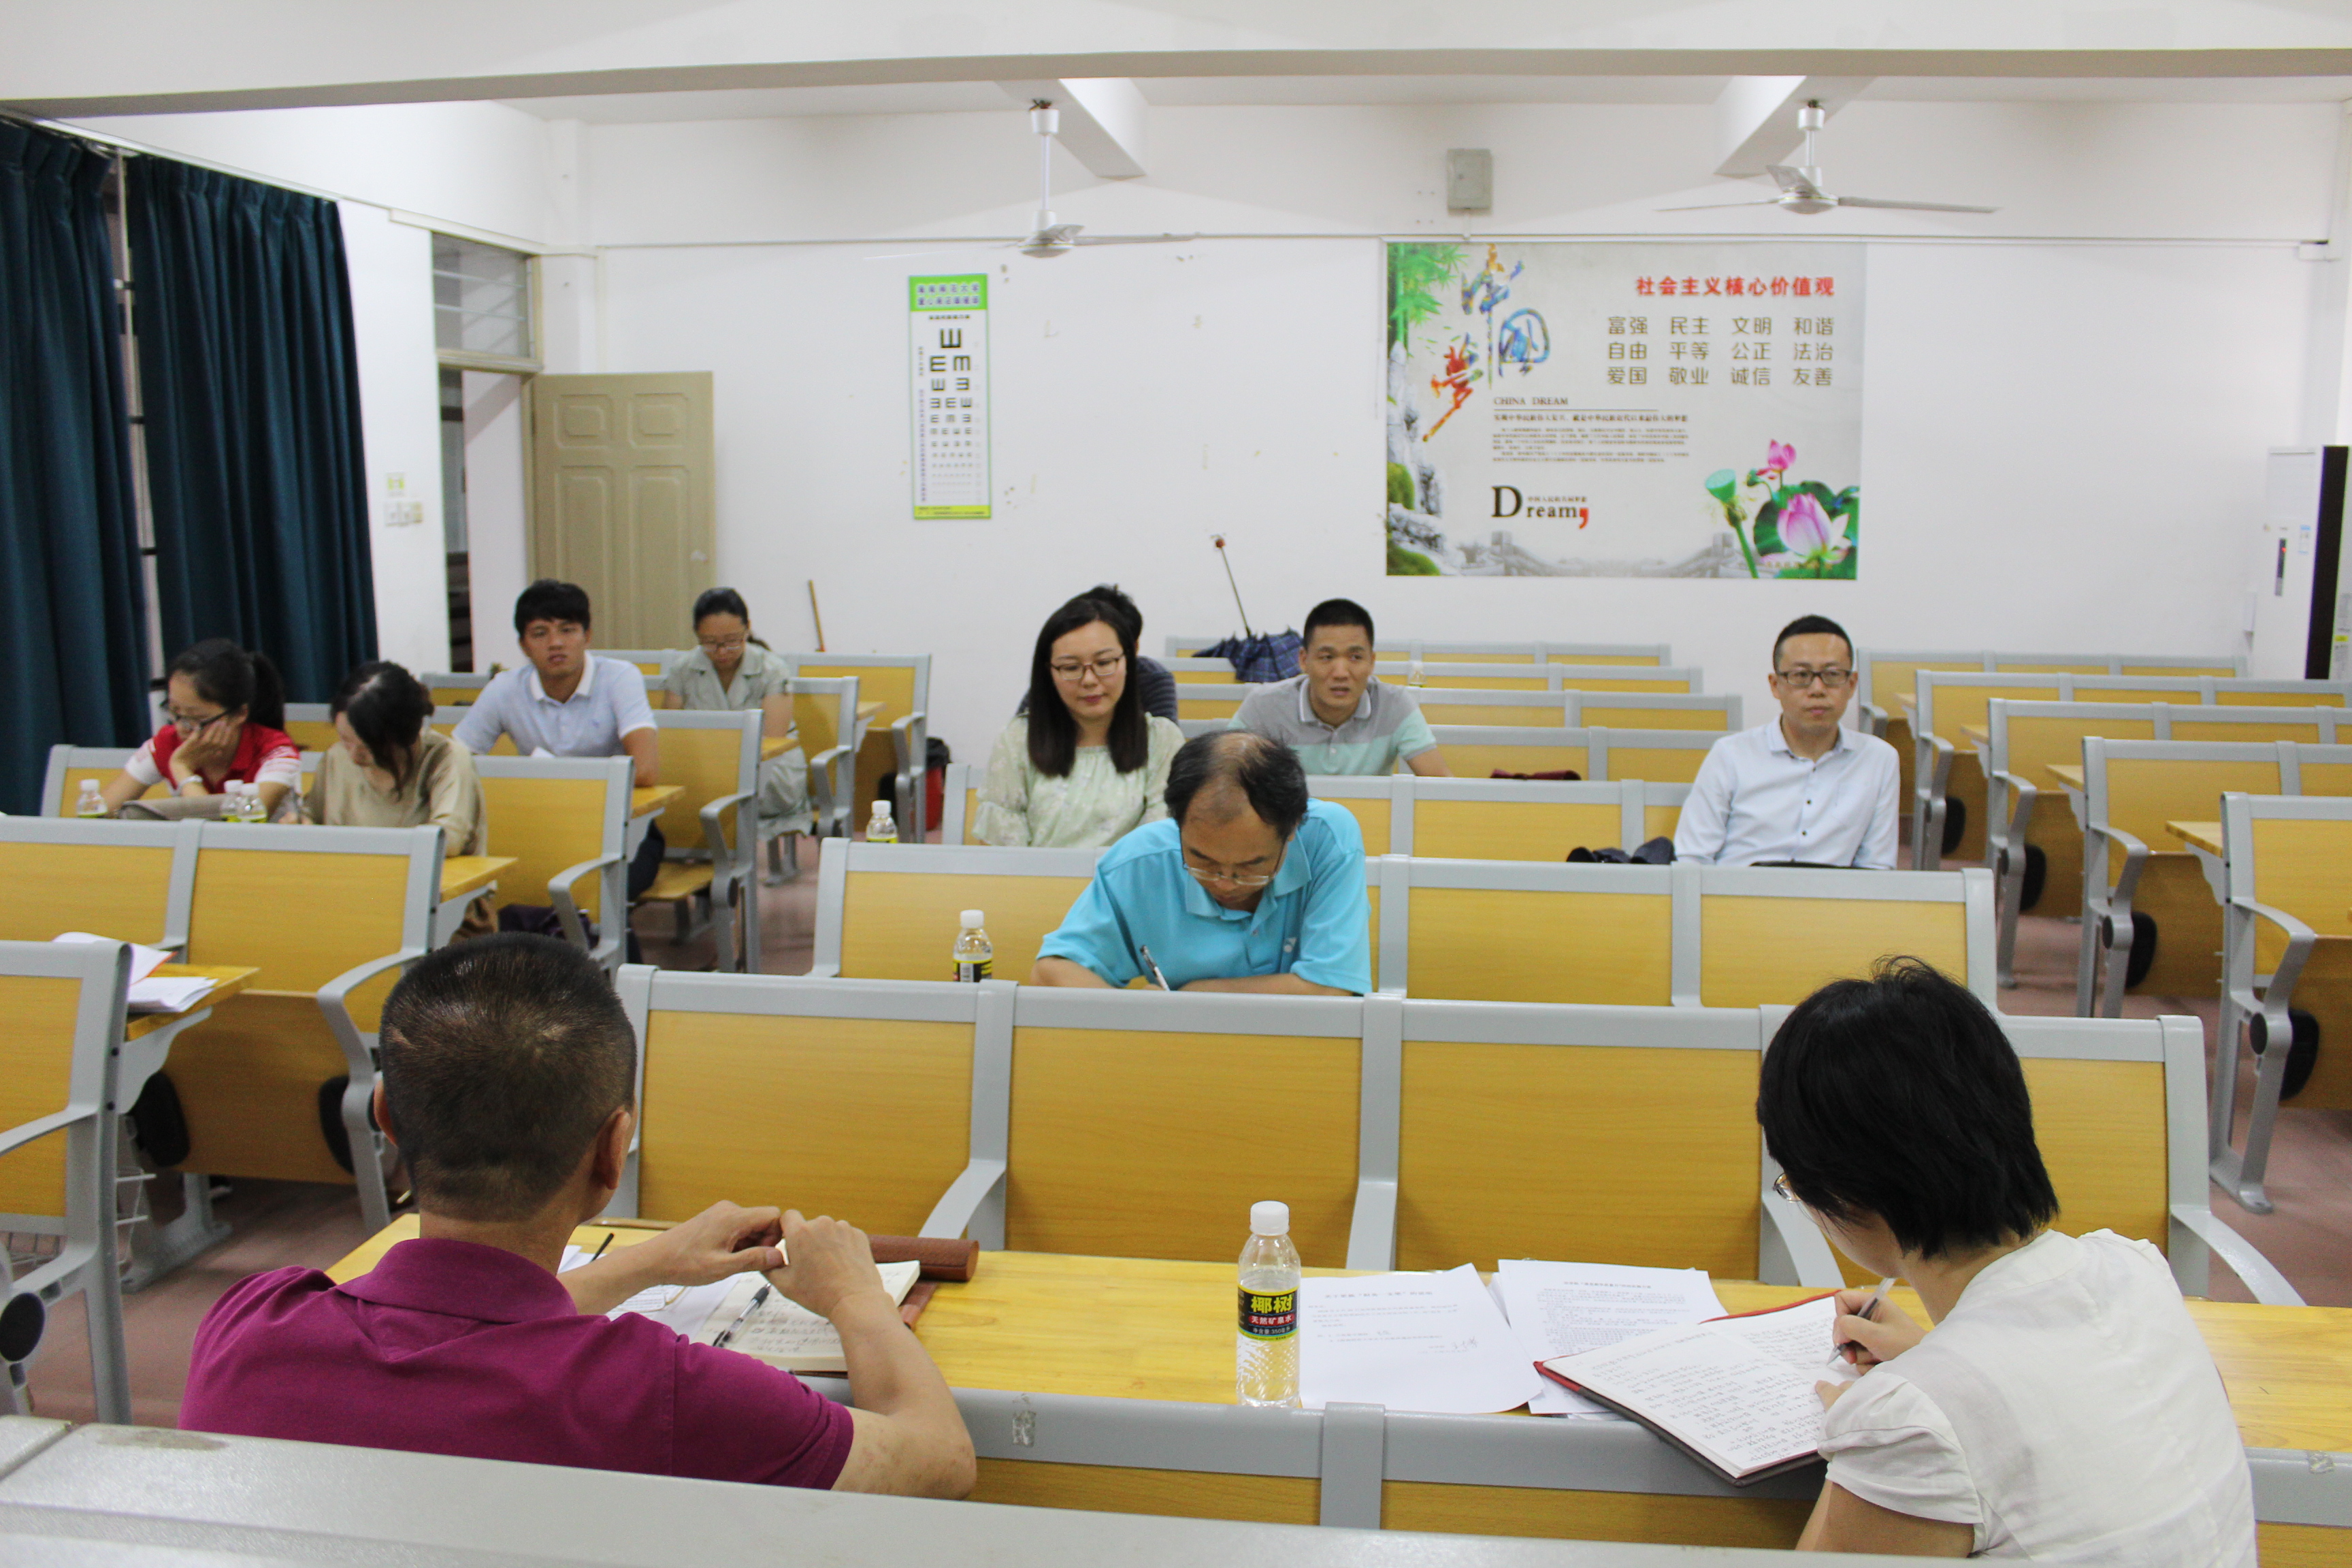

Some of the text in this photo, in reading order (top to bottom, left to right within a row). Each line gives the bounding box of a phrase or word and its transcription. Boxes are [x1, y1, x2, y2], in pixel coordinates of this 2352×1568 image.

[1636, 276, 1835, 297] 社会主义核心价值观
[1608, 316, 1834, 336] 富强 民主 文明 和谐
[1608, 342, 1833, 361] 自由 平等 公正 法治
[1607, 366, 1833, 386] 爱国 敬业 诚信 友善
[1494, 397, 1569, 406] CHINA DREAM
[1251, 1294, 1293, 1313] 椰树
[1252, 1314, 1292, 1325] 天然矿泉水
